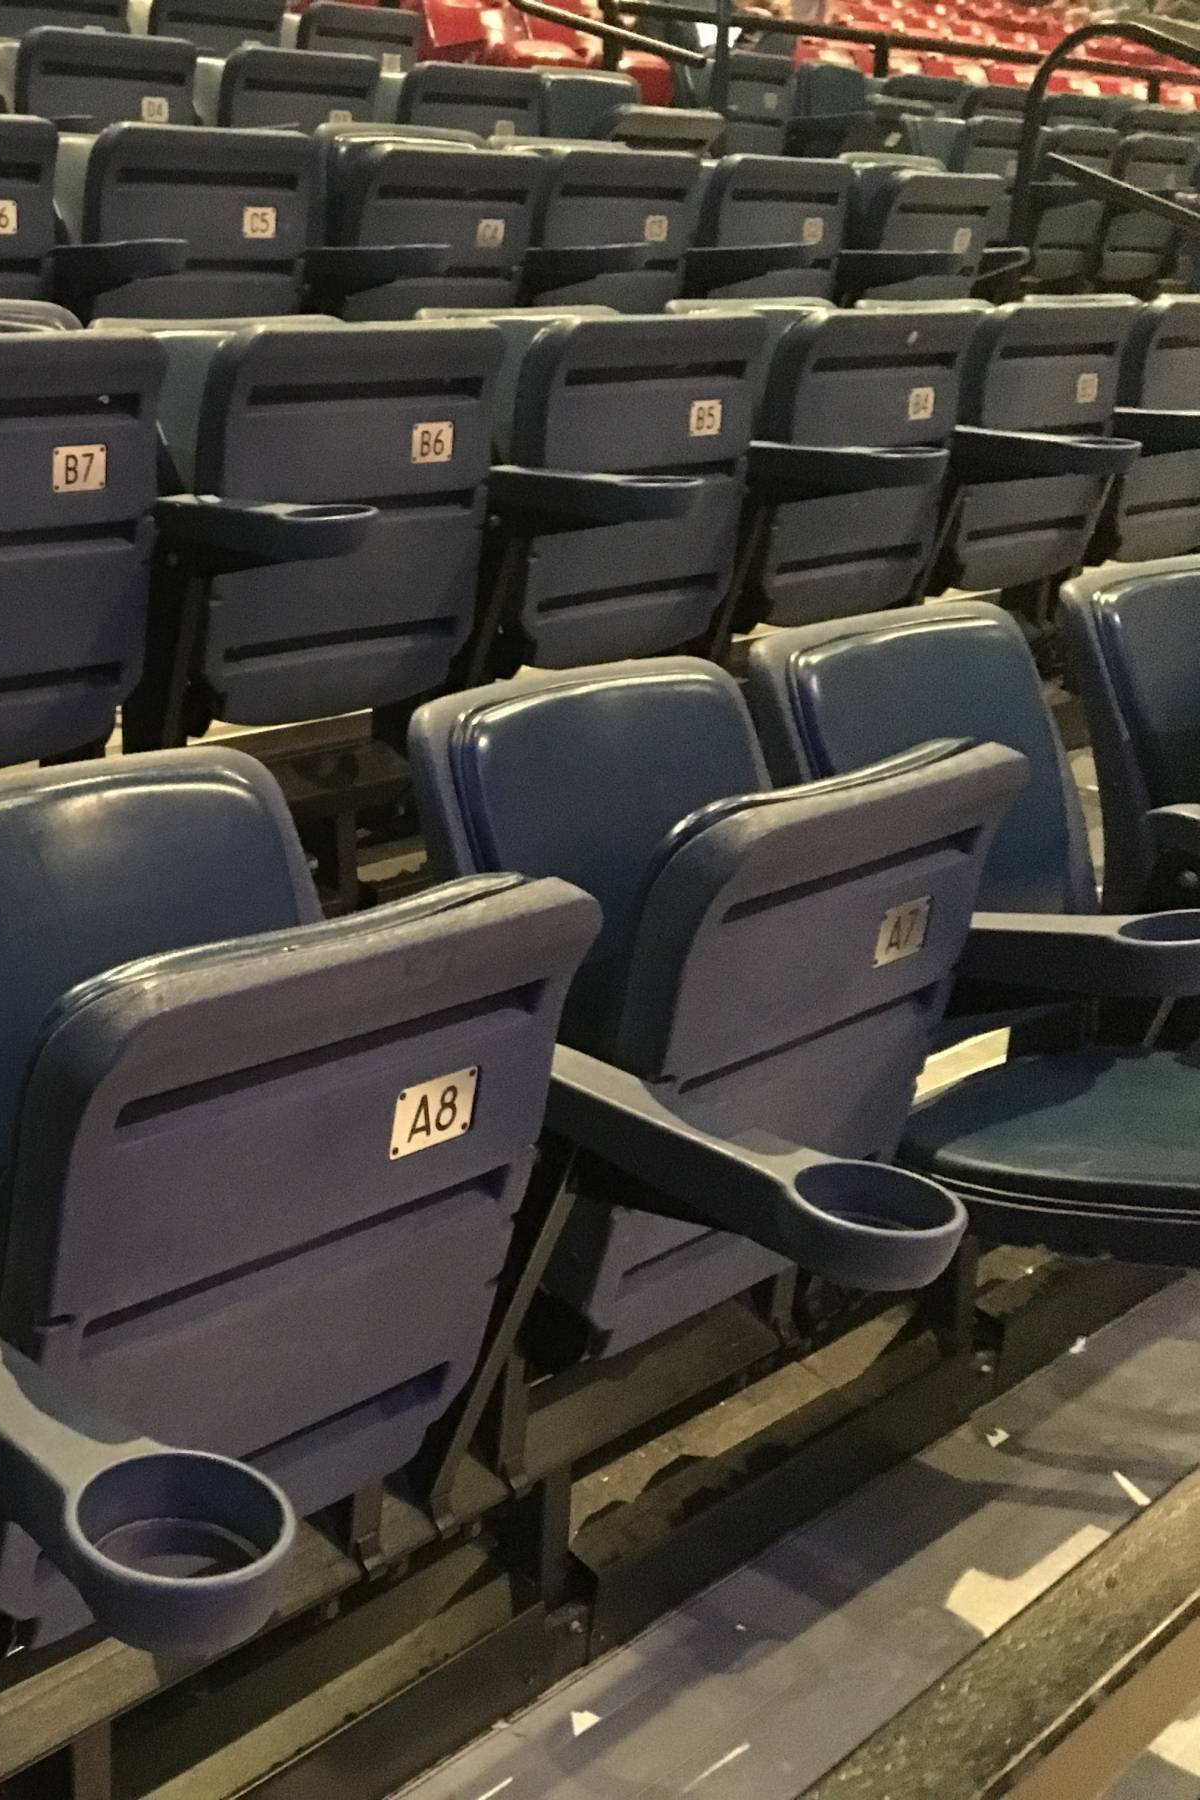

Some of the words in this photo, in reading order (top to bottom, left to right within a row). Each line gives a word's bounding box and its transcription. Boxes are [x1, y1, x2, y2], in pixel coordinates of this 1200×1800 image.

[250, 212, 269, 233] C5
[697, 406, 714, 430] B5
[420, 429, 443, 457] B6
[64, 453, 94, 484] B7
[886, 908, 917, 950] A7
[407, 1085, 458, 1143] A8
